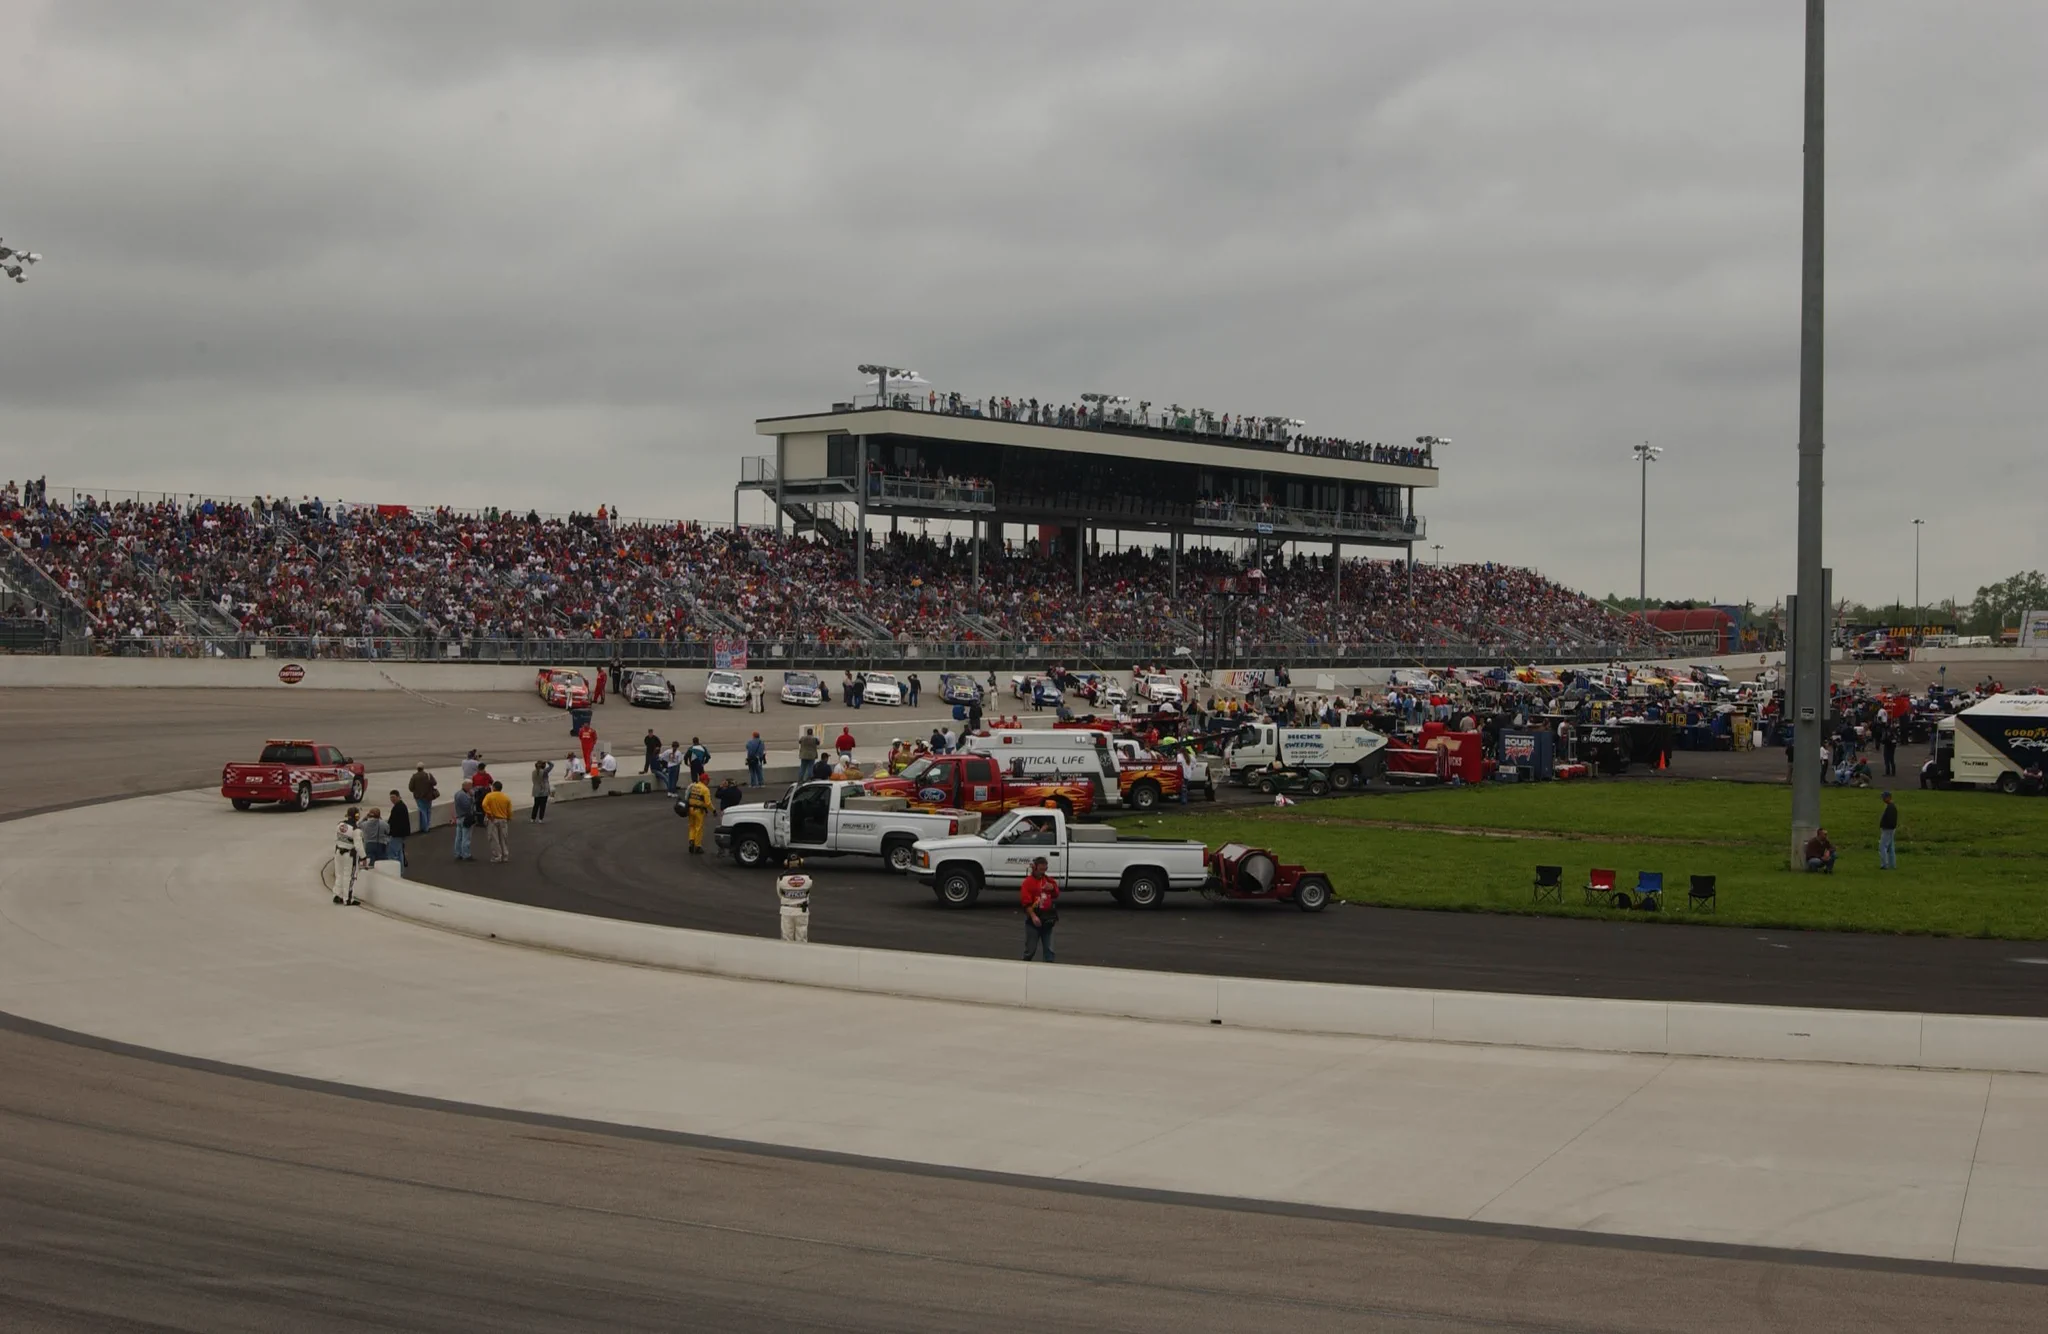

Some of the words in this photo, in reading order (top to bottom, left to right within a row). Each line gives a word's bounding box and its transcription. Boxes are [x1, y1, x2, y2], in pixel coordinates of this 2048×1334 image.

[1505, 738, 1535, 746] ROUSH
[1009, 756, 1057, 765] CRITICAL
[1062, 756, 1085, 764] LIFE
